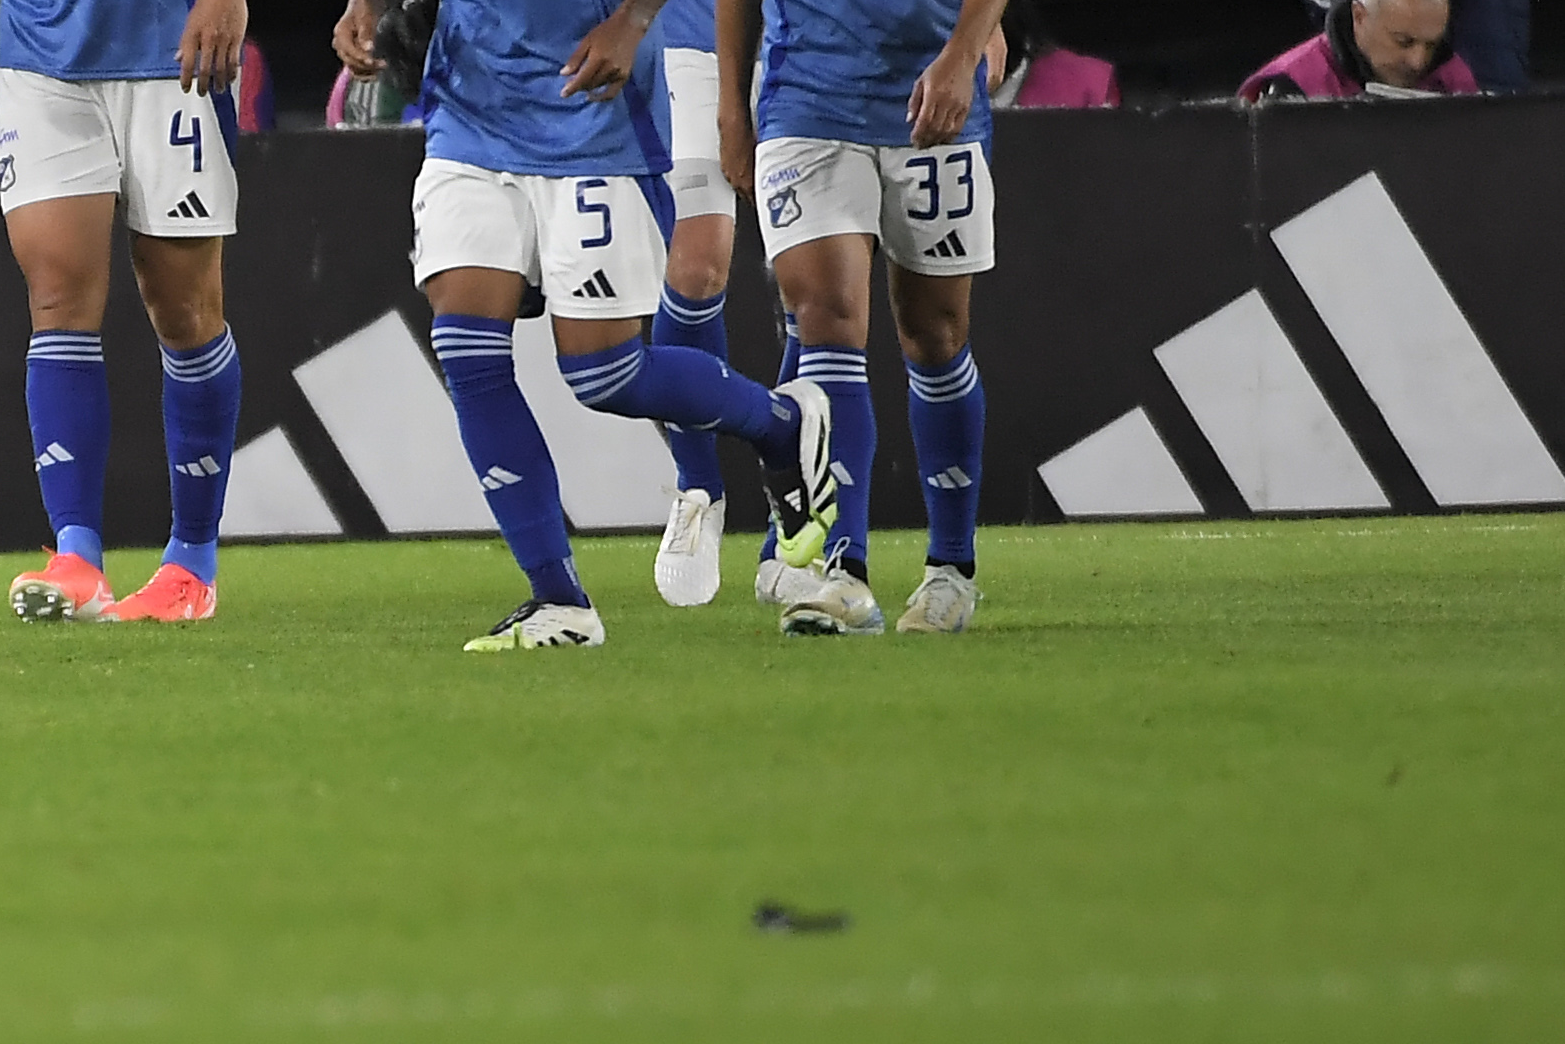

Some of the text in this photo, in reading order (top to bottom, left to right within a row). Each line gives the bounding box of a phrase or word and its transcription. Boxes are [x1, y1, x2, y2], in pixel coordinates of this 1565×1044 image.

[169, 109, 202, 172] 4
[576, 178, 612, 249] 5
[906, 150, 973, 220] 33
